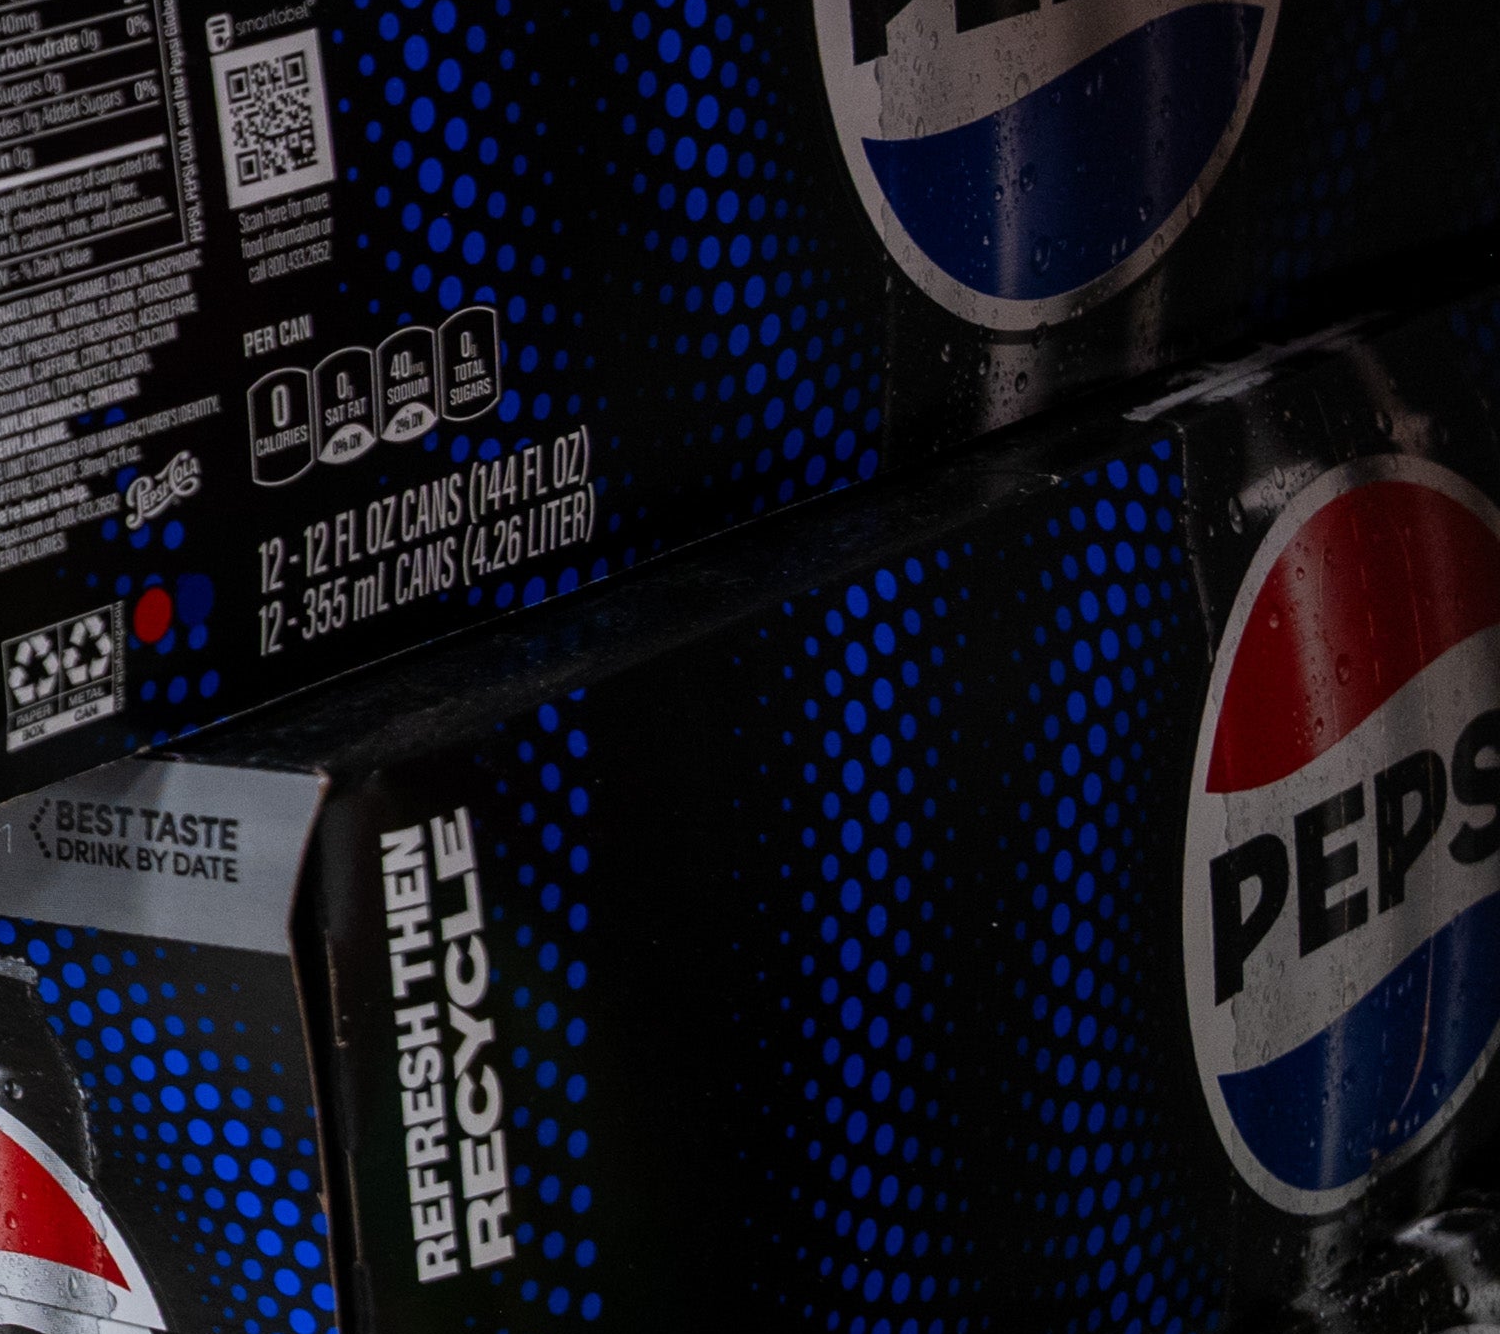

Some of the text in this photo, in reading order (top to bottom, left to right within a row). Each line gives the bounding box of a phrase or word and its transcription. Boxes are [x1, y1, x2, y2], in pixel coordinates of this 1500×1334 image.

[258, 424, 590, 595] 12 12 FL OZ CANS (144 FL OZ)
[258, 482, 596, 657] 12 355 mL CANS (4.26 LITER)
[55, 800, 238, 851] BEST TASTE
[56, 837, 239, 883] DRINK BY DATE
[1209, 708, 1500, 1008] PEPS
[380, 824, 461, 1283] REFRESH THEN
[431, 806, 516, 1269] RECYCLE
